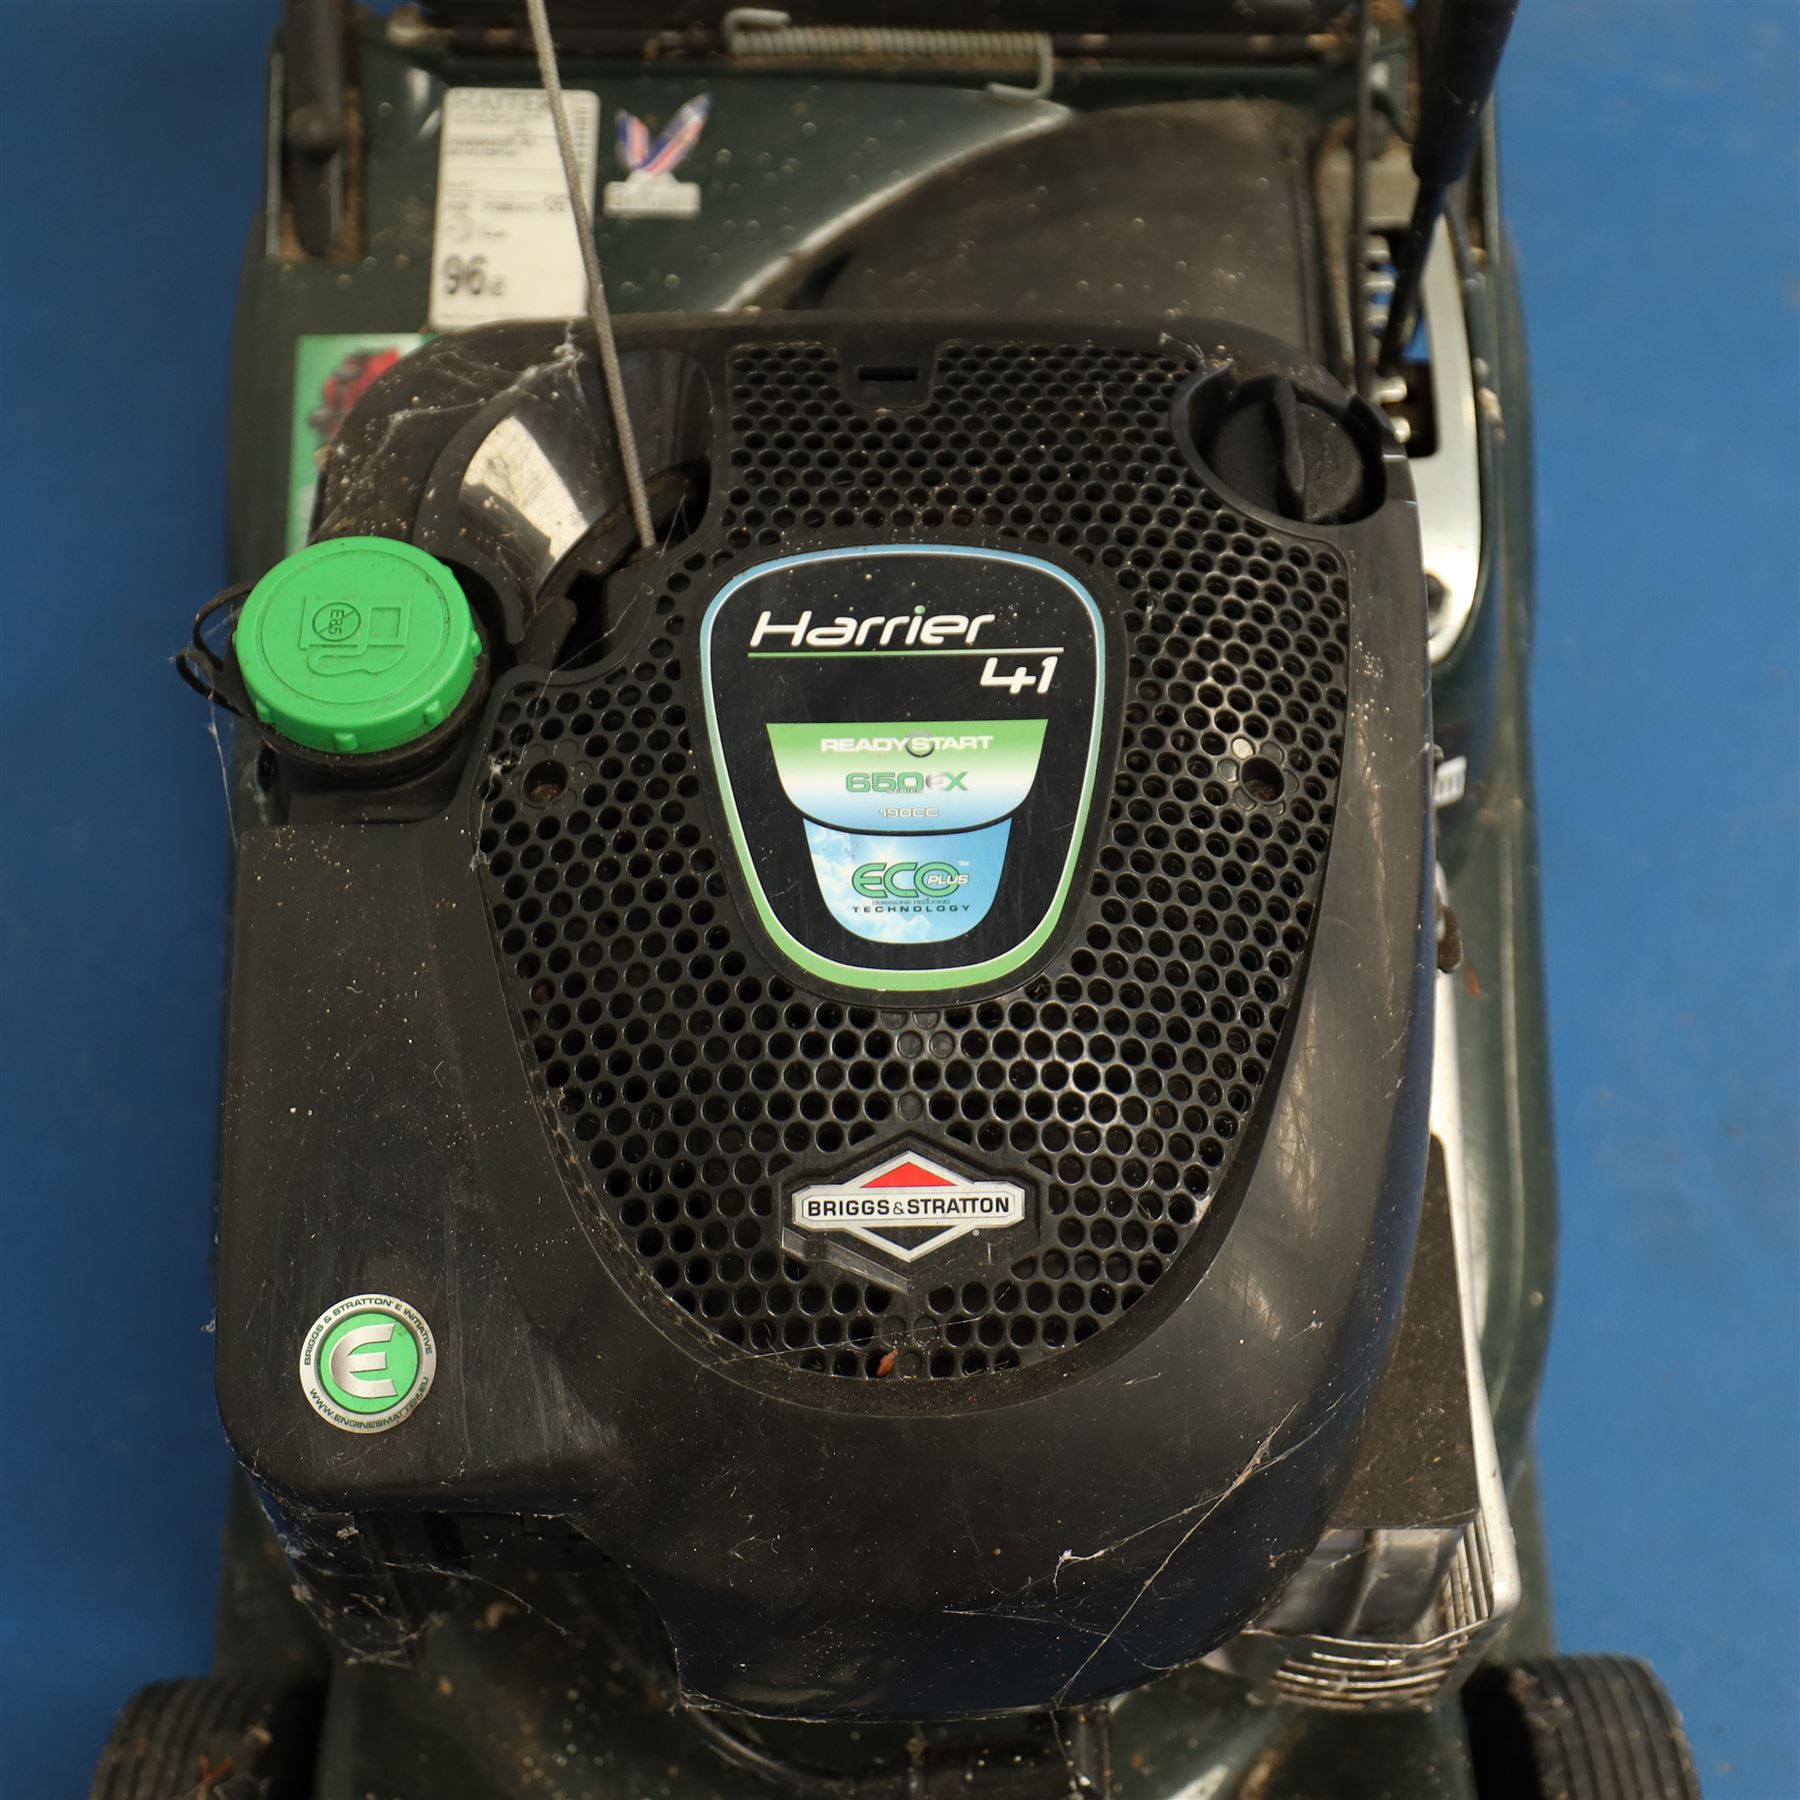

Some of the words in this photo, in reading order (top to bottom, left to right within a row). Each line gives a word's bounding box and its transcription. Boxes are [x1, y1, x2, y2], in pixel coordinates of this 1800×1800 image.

[442, 253, 487, 296] 96
[329, 609, 344, 635] E85
[750, 605, 996, 648] Harrier
[980, 656, 1059, 695] 41
[879, 807, 940, 818] 190CC
[851, 861, 961, 898] ECO
[927, 874, 969, 885] PLUS
[852, 904, 971, 914] TECHNOLOGY
[304, 1324, 324, 1366] BRIGGS
[323, 1315, 332, 1324] &
[394, 1303, 403, 1312] E
[403, 1308, 433, 1355] INITIATIVE
